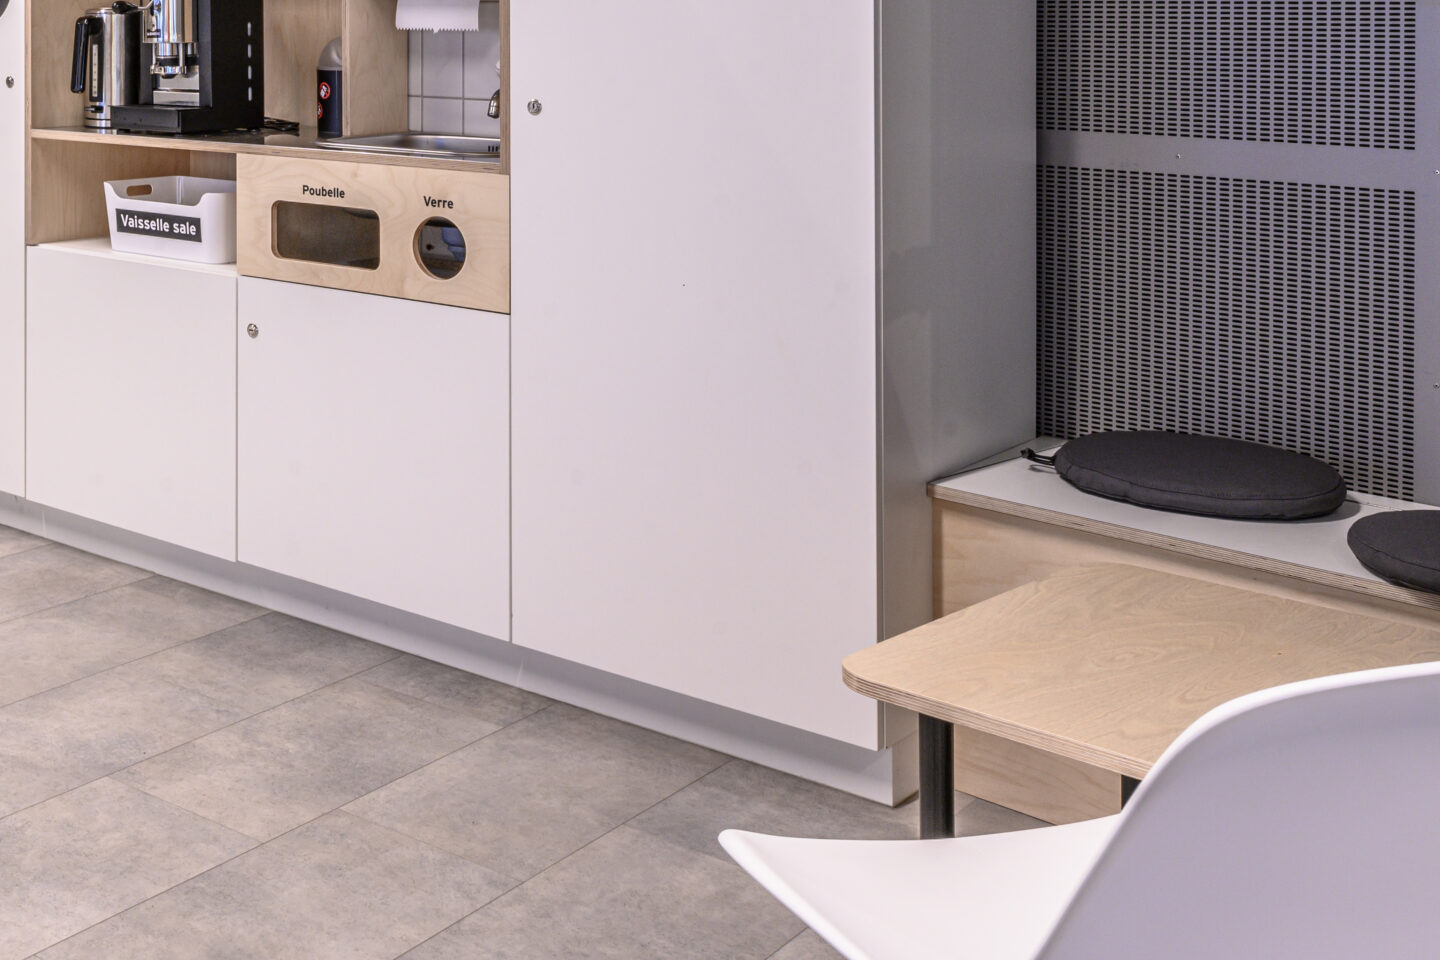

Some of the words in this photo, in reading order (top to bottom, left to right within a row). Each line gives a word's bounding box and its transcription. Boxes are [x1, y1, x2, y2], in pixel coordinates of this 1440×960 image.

[302, 185, 346, 199] Poubelle
[423, 196, 454, 210] Verre
[120, 213, 170, 233] Vaisselle
[172, 219, 198, 236] sale
